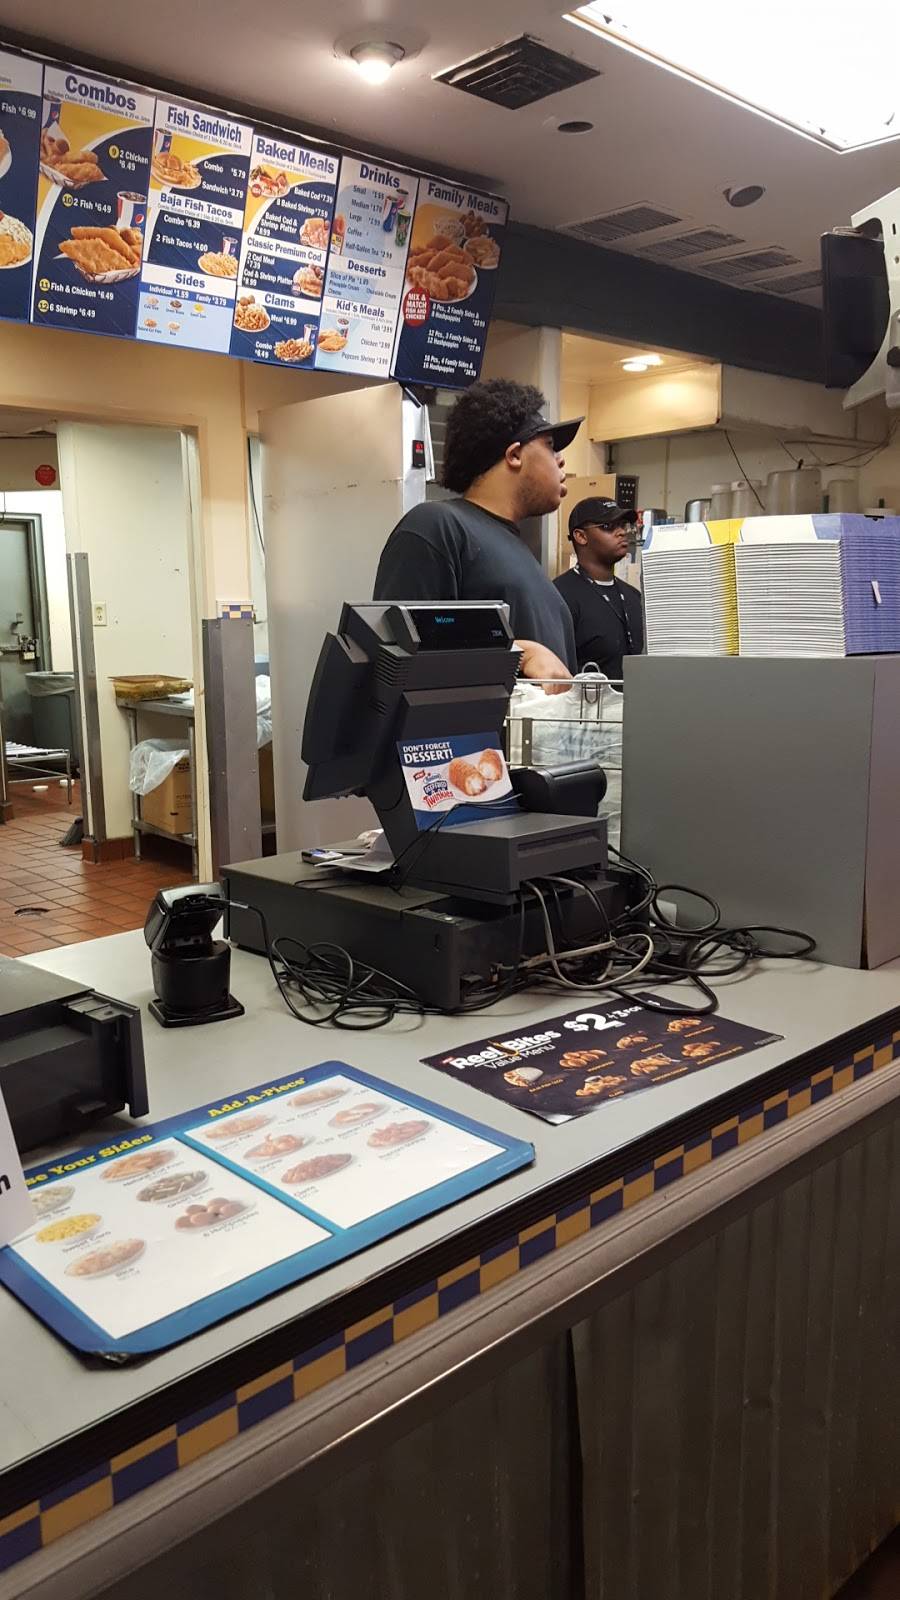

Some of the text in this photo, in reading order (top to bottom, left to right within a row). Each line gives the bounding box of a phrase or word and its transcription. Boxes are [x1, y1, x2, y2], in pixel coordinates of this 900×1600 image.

[65, 75, 137, 111] Combos
[1, 102, 17, 114] Fish
[168, 106, 189, 128] Fish
[192, 114, 242, 143] Sandwich
[119, 150, 149, 164] 2 Chicken
[256, 138, 296, 163] Baked
[298, 150, 335, 174] Meals
[204, 161, 223, 173] Combo
[359, 163, 400, 189] Drinks
[202, 181, 228, 195] Sandwich
[294, 187, 310, 198] Baked
[310, 191, 320, 201] Cod
[353, 185, 367, 195] Small
[73, 198, 79, 206] 2
[80, 199, 93, 210] Fish
[160, 192, 182, 207] Baja
[185, 199, 204, 213] Fish
[207, 204, 233, 218] Tacos
[351, 199, 370, 210] Medium
[427, 182, 499, 216] Family Meals
[281, 199, 297, 210] Baked
[297, 204, 315, 216] Shrimp
[163, 214, 185, 226] Combo
[265, 212, 282, 223] Baked
[283, 216, 292, 224] Cod
[349, 211, 363, 223] Large
[260, 219, 297, 234] Shrimp Platter
[347, 227, 363, 238] Coffee
[162, 235, 175, 245] Fish
[176, 238, 193, 248] Tacos
[247, 237, 322, 262] Classic Premium Cod
[371, 248, 379, 256] Tea
[252, 254, 262, 262] Cod
[263, 256, 275, 265] Meal
[347, 259, 387, 278] Desserts
[175, 273, 205, 288] Sides
[243, 269, 254, 278] Cod
[259, 272, 277, 283] Shrimp
[277, 275, 293, 285] Platter
[330, 271, 343, 281] Slice
[50, 283, 64, 292] Fish
[65, 285, 70, 294] &
[71, 286, 97, 298] Chicken
[149, 286, 173, 296] Individual
[195, 294, 211, 303] Family
[408, 293, 420, 301] MIX
[264, 293, 295, 309] Clams
[49, 303, 54, 311] 6
[55, 304, 78, 316] Shrimp
[336, 299, 358, 313] Kid's
[359, 304, 385, 318] Meals
[451, 307, 464, 316] Family
[464, 310, 475, 318] Sides
[270, 315, 284, 323] Meal
[435, 311, 461, 323] Hushpuppies
[371, 323, 381, 332] Fish
[433, 338, 459, 349] Hushpuppies
[449, 333, 462, 343] Family
[462, 336, 473, 344] Sides
[255, 341, 272, 350] Combo
[429, 363, 455, 374] Hushpuppies
[445, 358, 458, 368] Family
[458, 360, 469, 369] Sides
[403, 741, 450, 753] DON'T FORGET
[403, 748, 454, 764] DESSERT!
[563, 1013, 626, 1031] $2
[450, 1030, 562, 1069] Reel Bites
[484, 1044, 556, 1069] Value Menu
[208, 1078, 306, 1117] Add-A-Piece
[48, 1155, 97, 1175] Your
[99, 1134, 153, 1157] Sides
